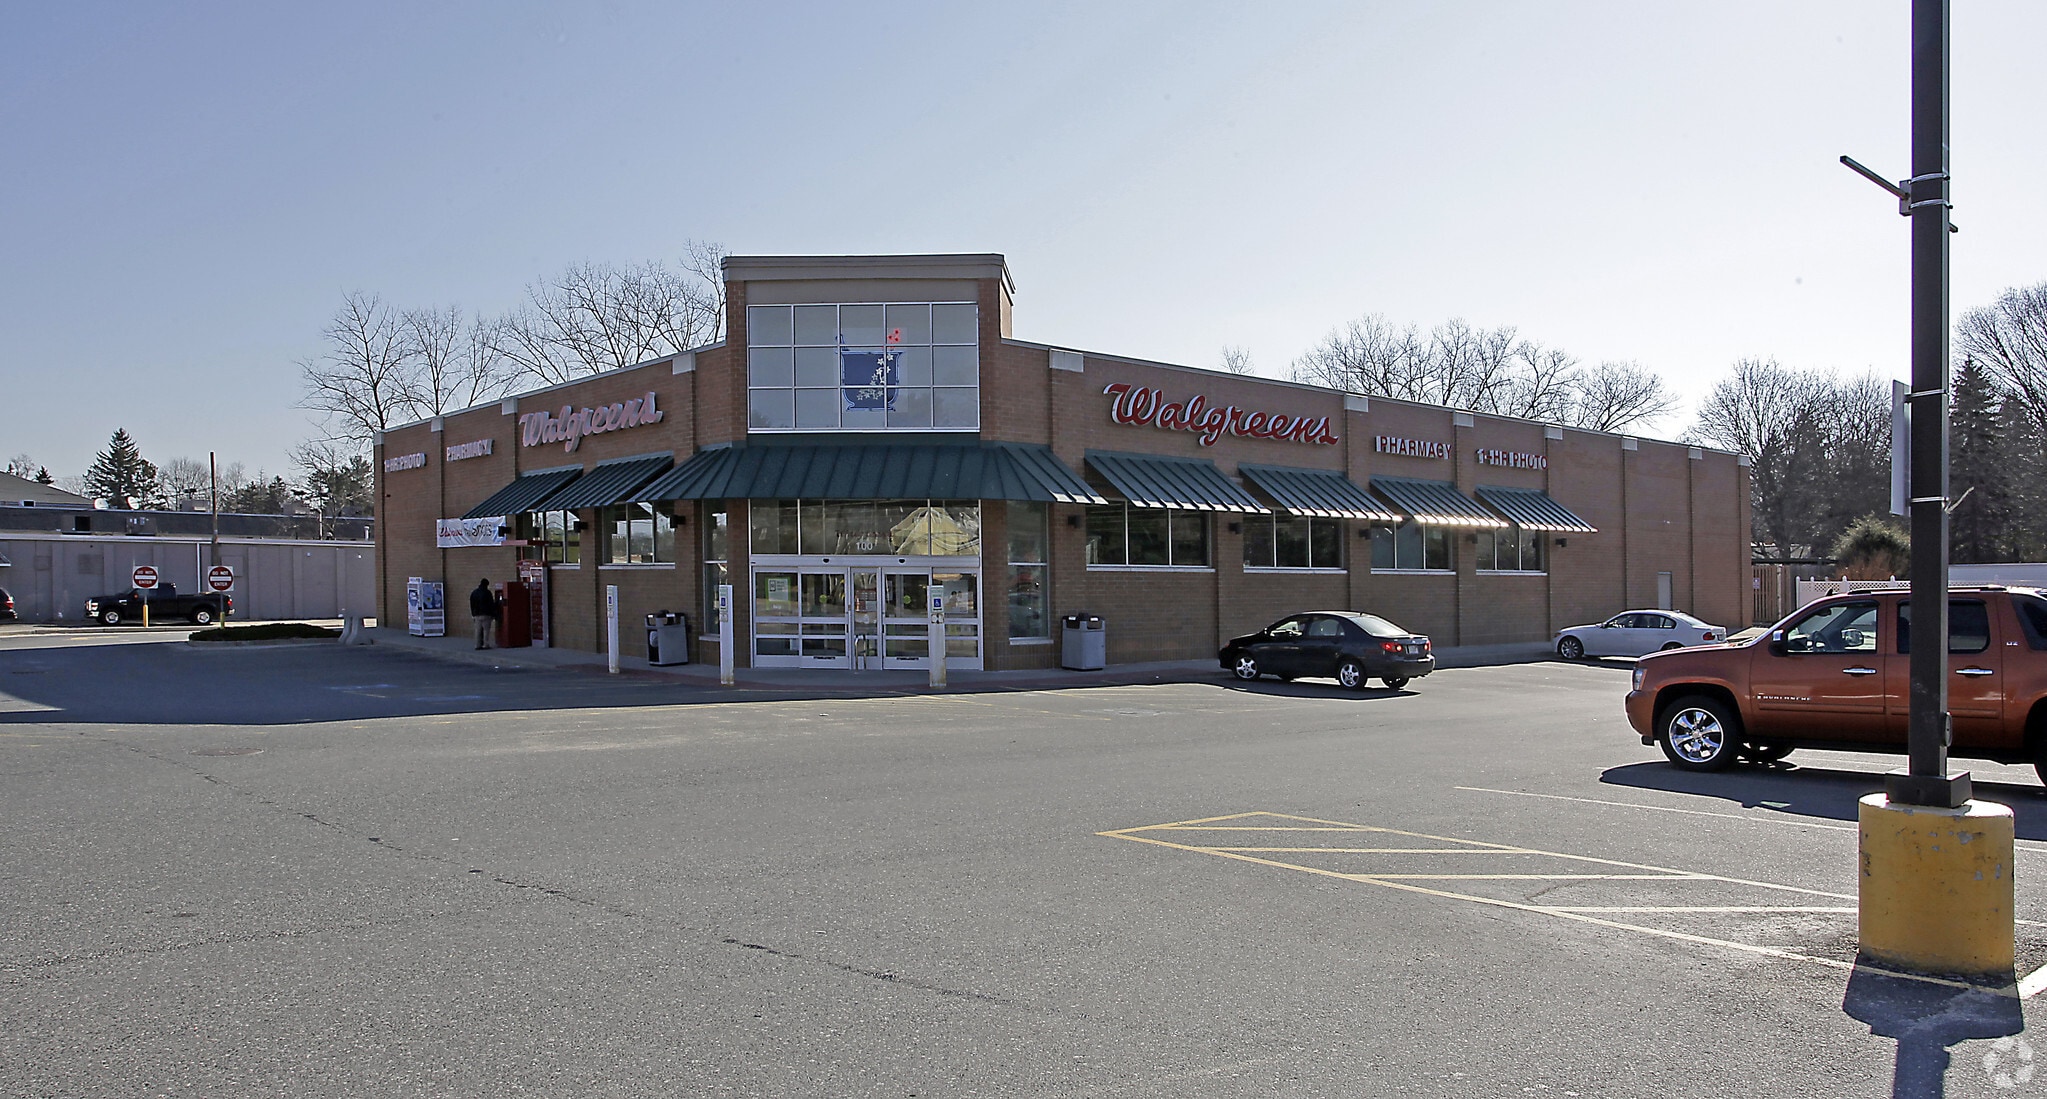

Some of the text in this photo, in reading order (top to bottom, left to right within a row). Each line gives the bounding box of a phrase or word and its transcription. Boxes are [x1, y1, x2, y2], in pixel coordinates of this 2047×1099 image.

[518, 391, 663, 453] Walgreens
[1103, 382, 1339, 447] Walgreens
[446, 439, 493, 462] PHARMACY
[1376, 436, 1451, 460] PHARMACY
[1477, 448, 1548, 470] 1-HR PHOTO
[400, 452, 425, 470] PHOTO
[856, 541, 873, 551] 100
